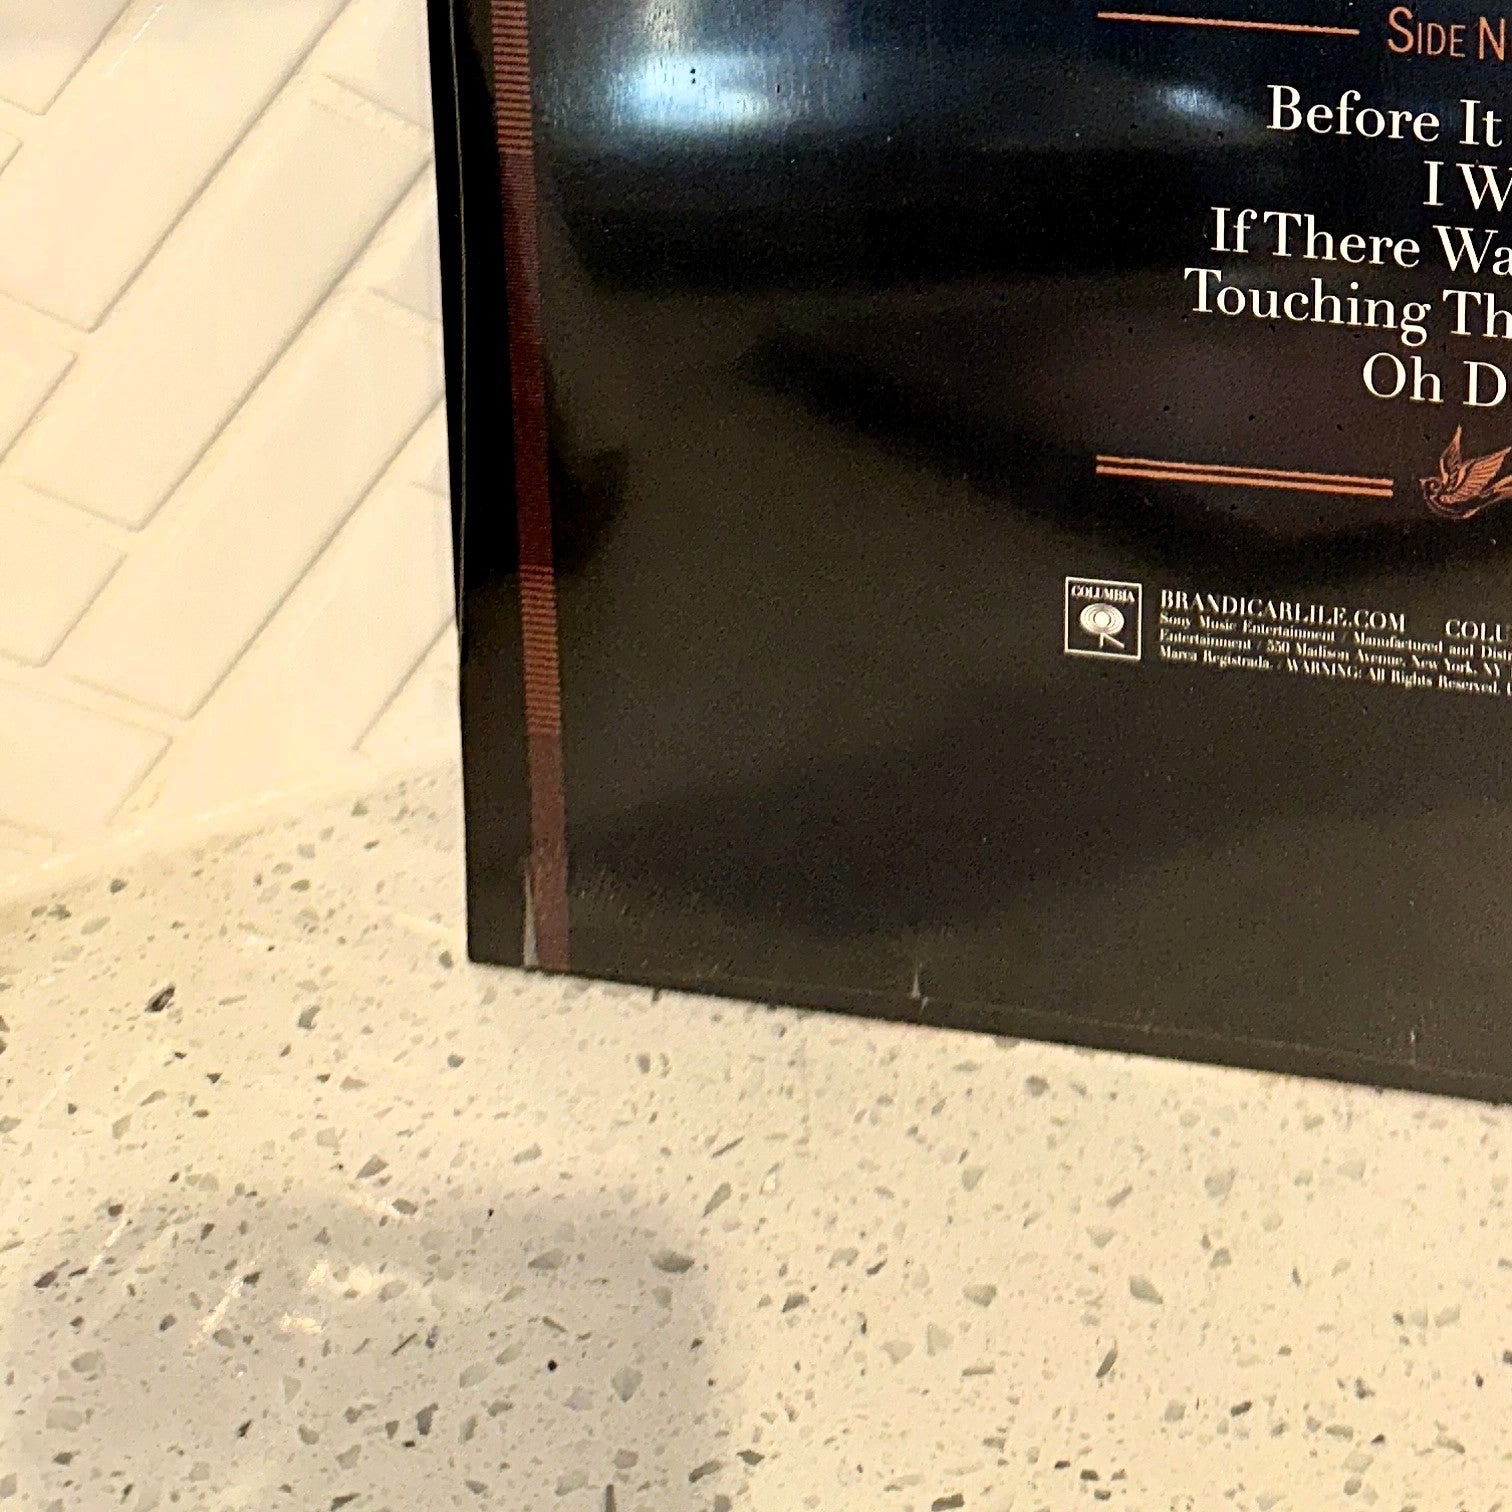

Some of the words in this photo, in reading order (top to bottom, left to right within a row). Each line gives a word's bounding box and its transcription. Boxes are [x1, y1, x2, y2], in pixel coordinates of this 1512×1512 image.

[1387, 6, 1466, 60] SIDE
[1266, 84, 1440, 144] Before
[1460, 99, 1502, 149] It
[1423, 161, 1441, 206] I
[1210, 207, 1253, 253] If
[1264, 211, 1421, 268] There
[1184, 266, 1432, 345] Touching
[1362, 352, 1444, 403] Oh
[1071, 585, 1136, 603] COLUMBIA
[1161, 589, 1405, 633] BRANDICARLILE.COM
[1160, 611, 1191, 630] Sony
[1199, 615, 1236, 631] Music
[1243, 619, 1335, 642] Entertainment
[1353, 631, 1443, 654] Manufactured
[1449, 644, 1473, 657] and
[1160, 628, 1251, 650] Entertainment
[1295, 642, 1349, 662] Madison
[1411, 654, 1438, 671] New
[1482, 661, 1501, 677] NY
[1159, 644, 1197, 663] Marca
[1369, 667, 1385, 683] All
[1391, 668, 1433, 688] Rights
